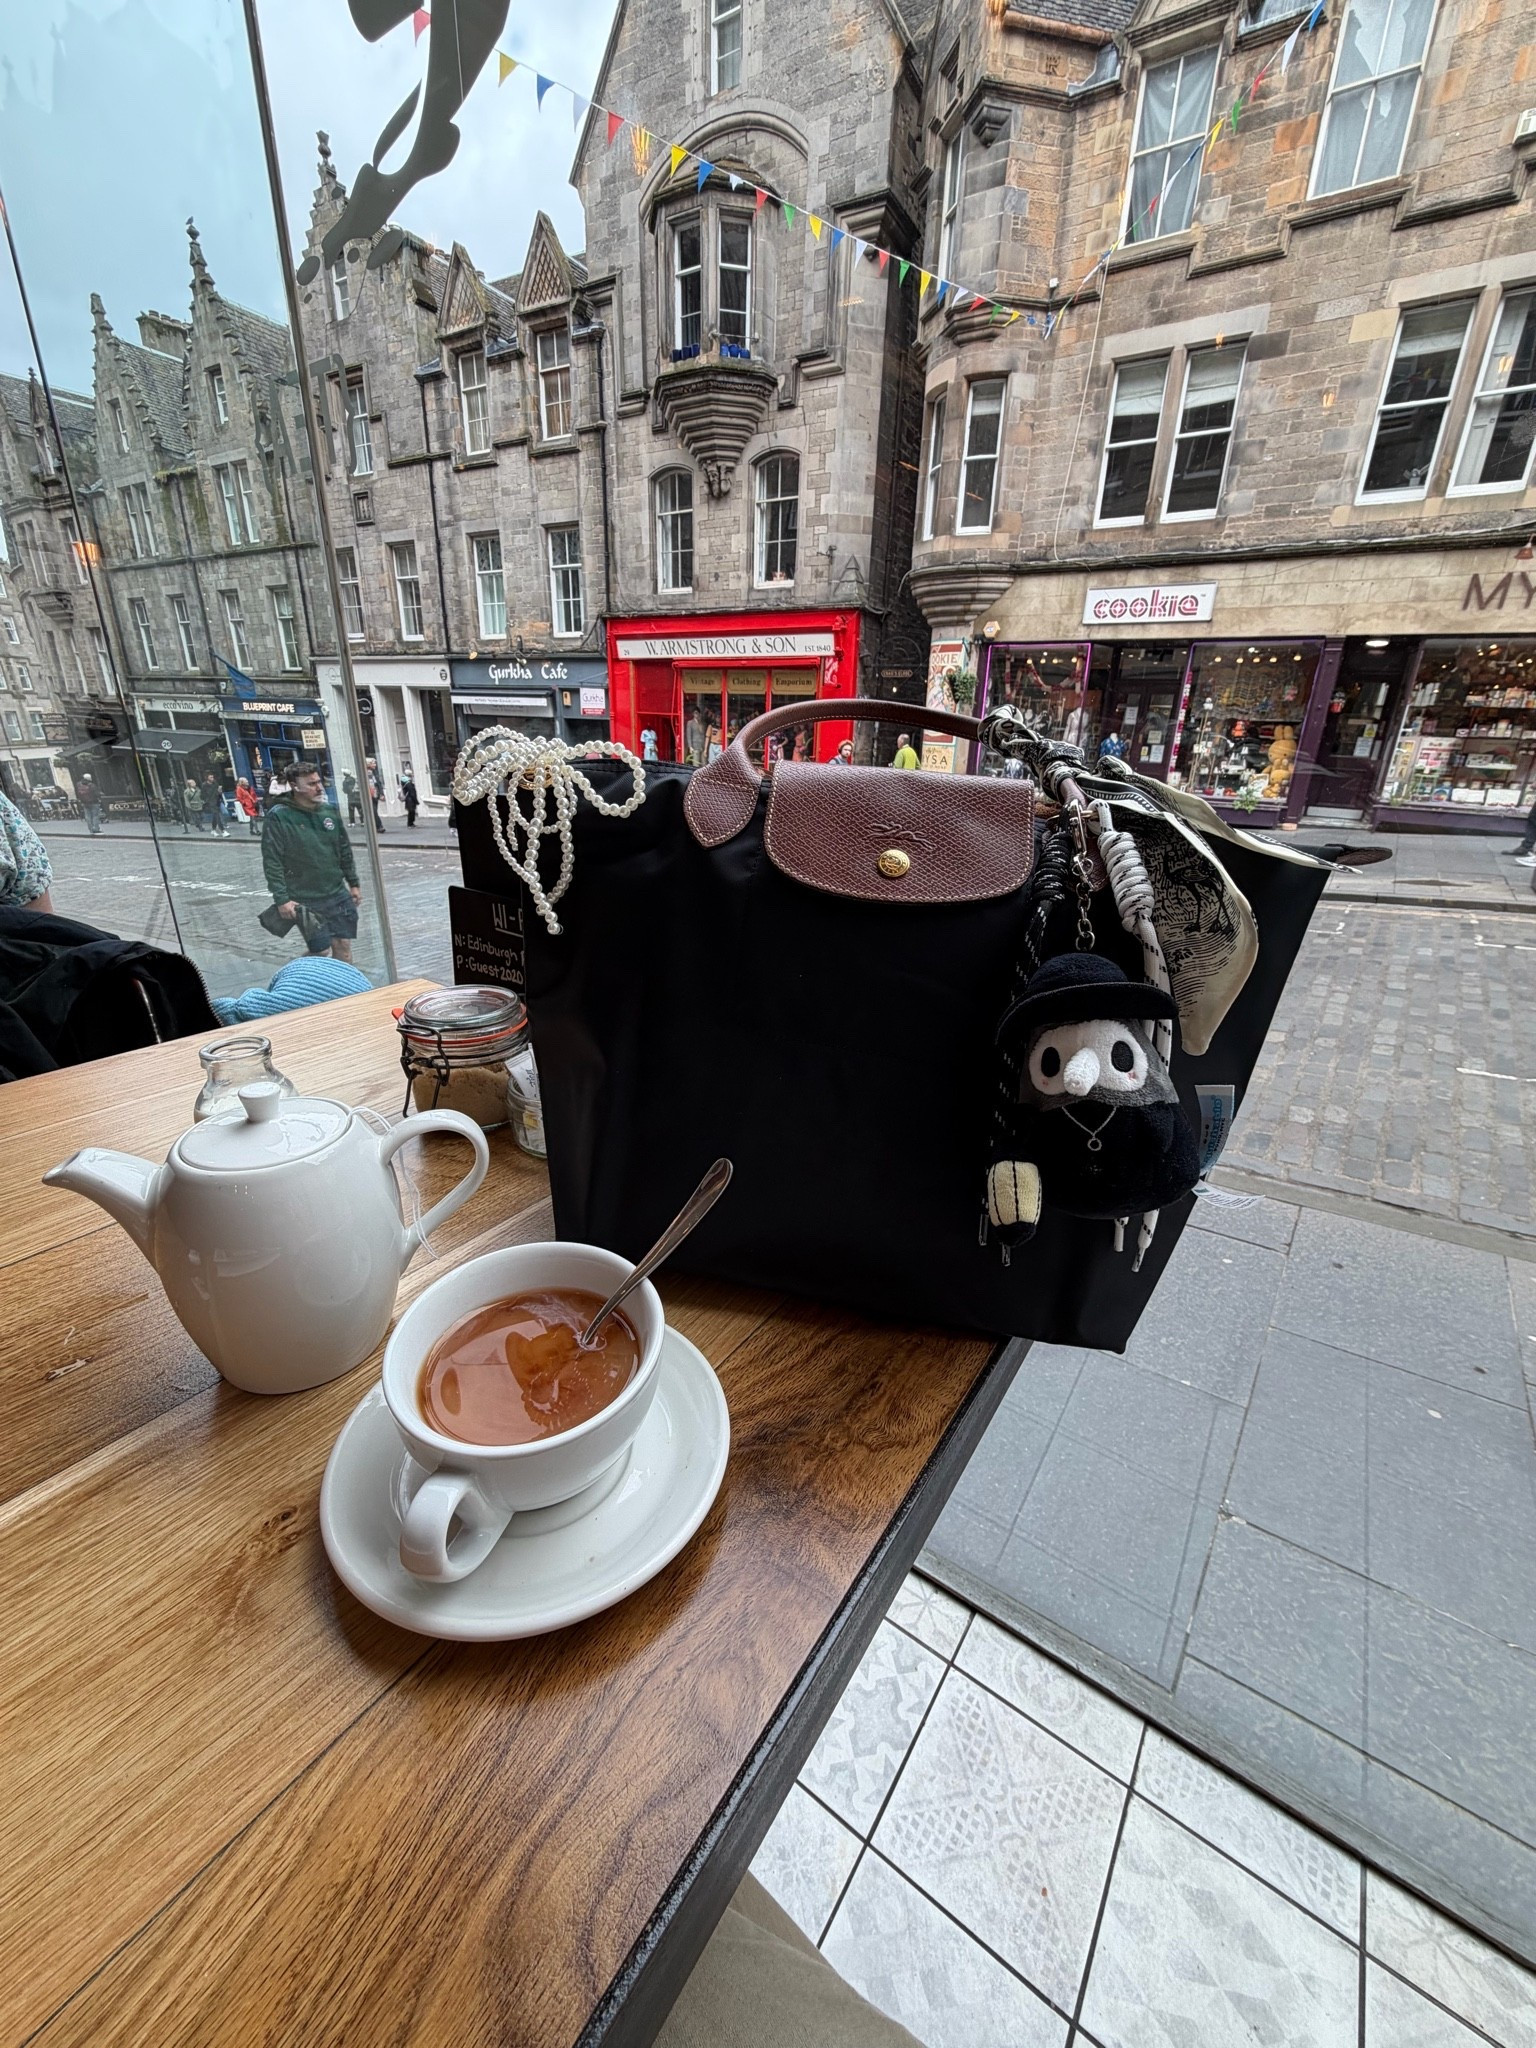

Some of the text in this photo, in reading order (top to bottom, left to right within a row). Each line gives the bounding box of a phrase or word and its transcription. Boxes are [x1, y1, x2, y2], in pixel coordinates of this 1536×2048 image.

[1093, 589, 1199, 619] cookie
[751, 637, 762, 654] &
[765, 636, 797, 653] SON
[816, 644, 831, 652] 1840
[930, 653, 958, 665] OOKIE
[488, 662, 568, 685] Gurkha Cafe
[732, 677, 761, 686] Clothing
[775, 676, 813, 686] Emporium
[242, 702, 295, 713] BLUEPRINT CAFE
